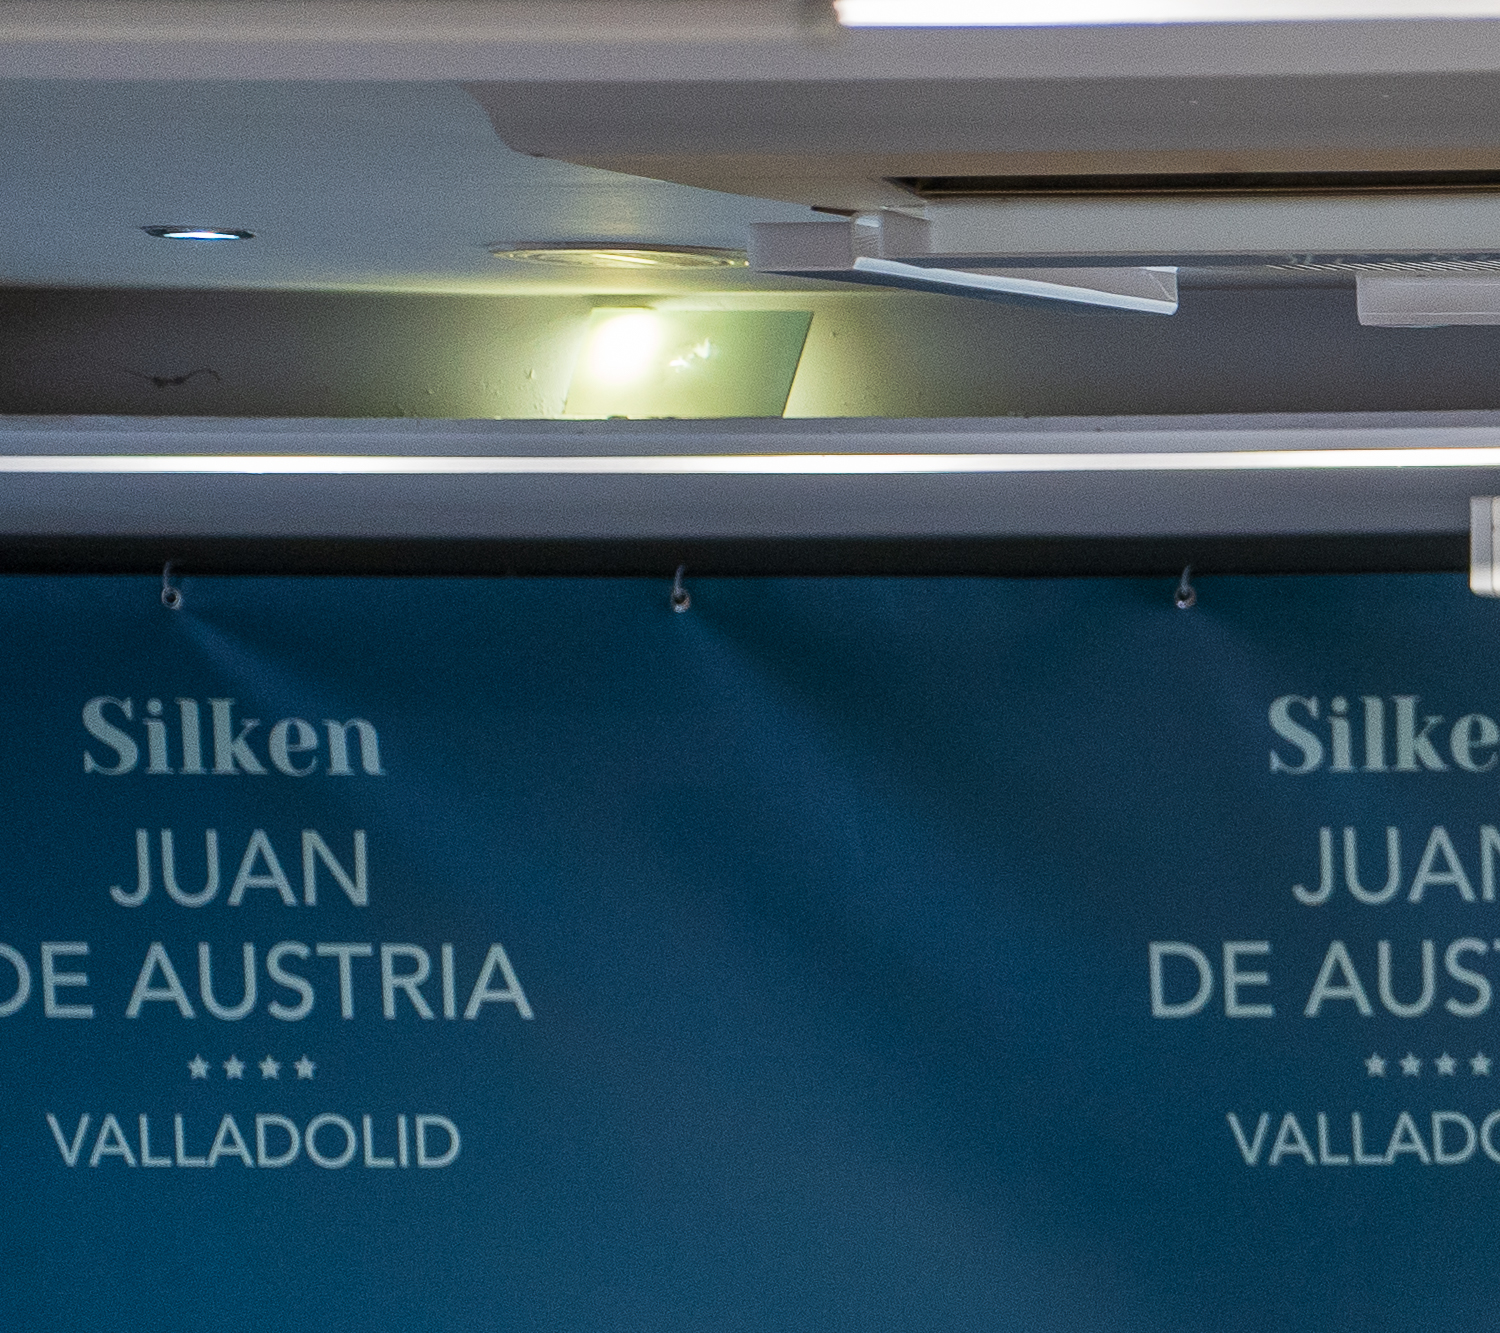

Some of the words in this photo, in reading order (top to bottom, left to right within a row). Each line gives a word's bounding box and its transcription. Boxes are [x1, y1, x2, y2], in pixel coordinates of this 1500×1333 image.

[82, 697, 384, 776] Silken
[110, 829, 369, 907] JUAN
[126, 941, 535, 1021] AUSTRIA
[1149, 941, 1275, 1018] DE
[46, 1113, 462, 1169] VALLADOLID
